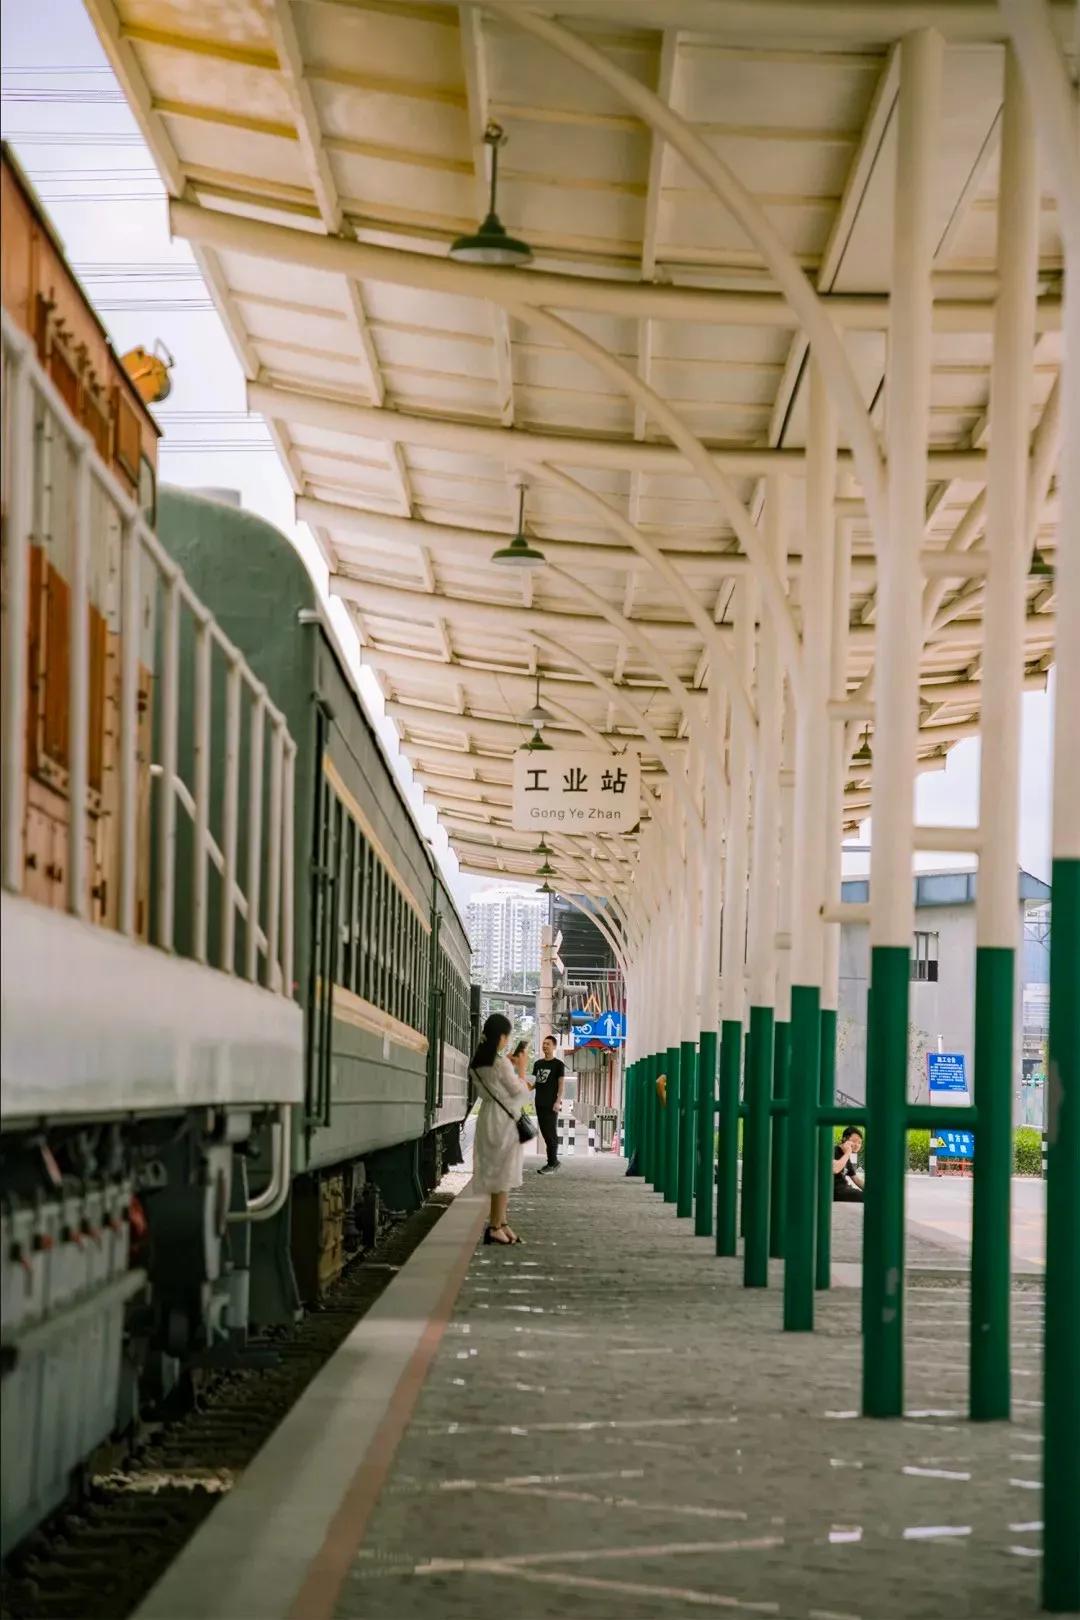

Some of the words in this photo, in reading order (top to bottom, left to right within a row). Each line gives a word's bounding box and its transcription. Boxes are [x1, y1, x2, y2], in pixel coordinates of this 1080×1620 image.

[525, 767, 628, 793] 工业站
[530, 807, 565, 820] Gong
[569, 808, 584, 819] Ye
[588, 808, 621, 819] Zhan
